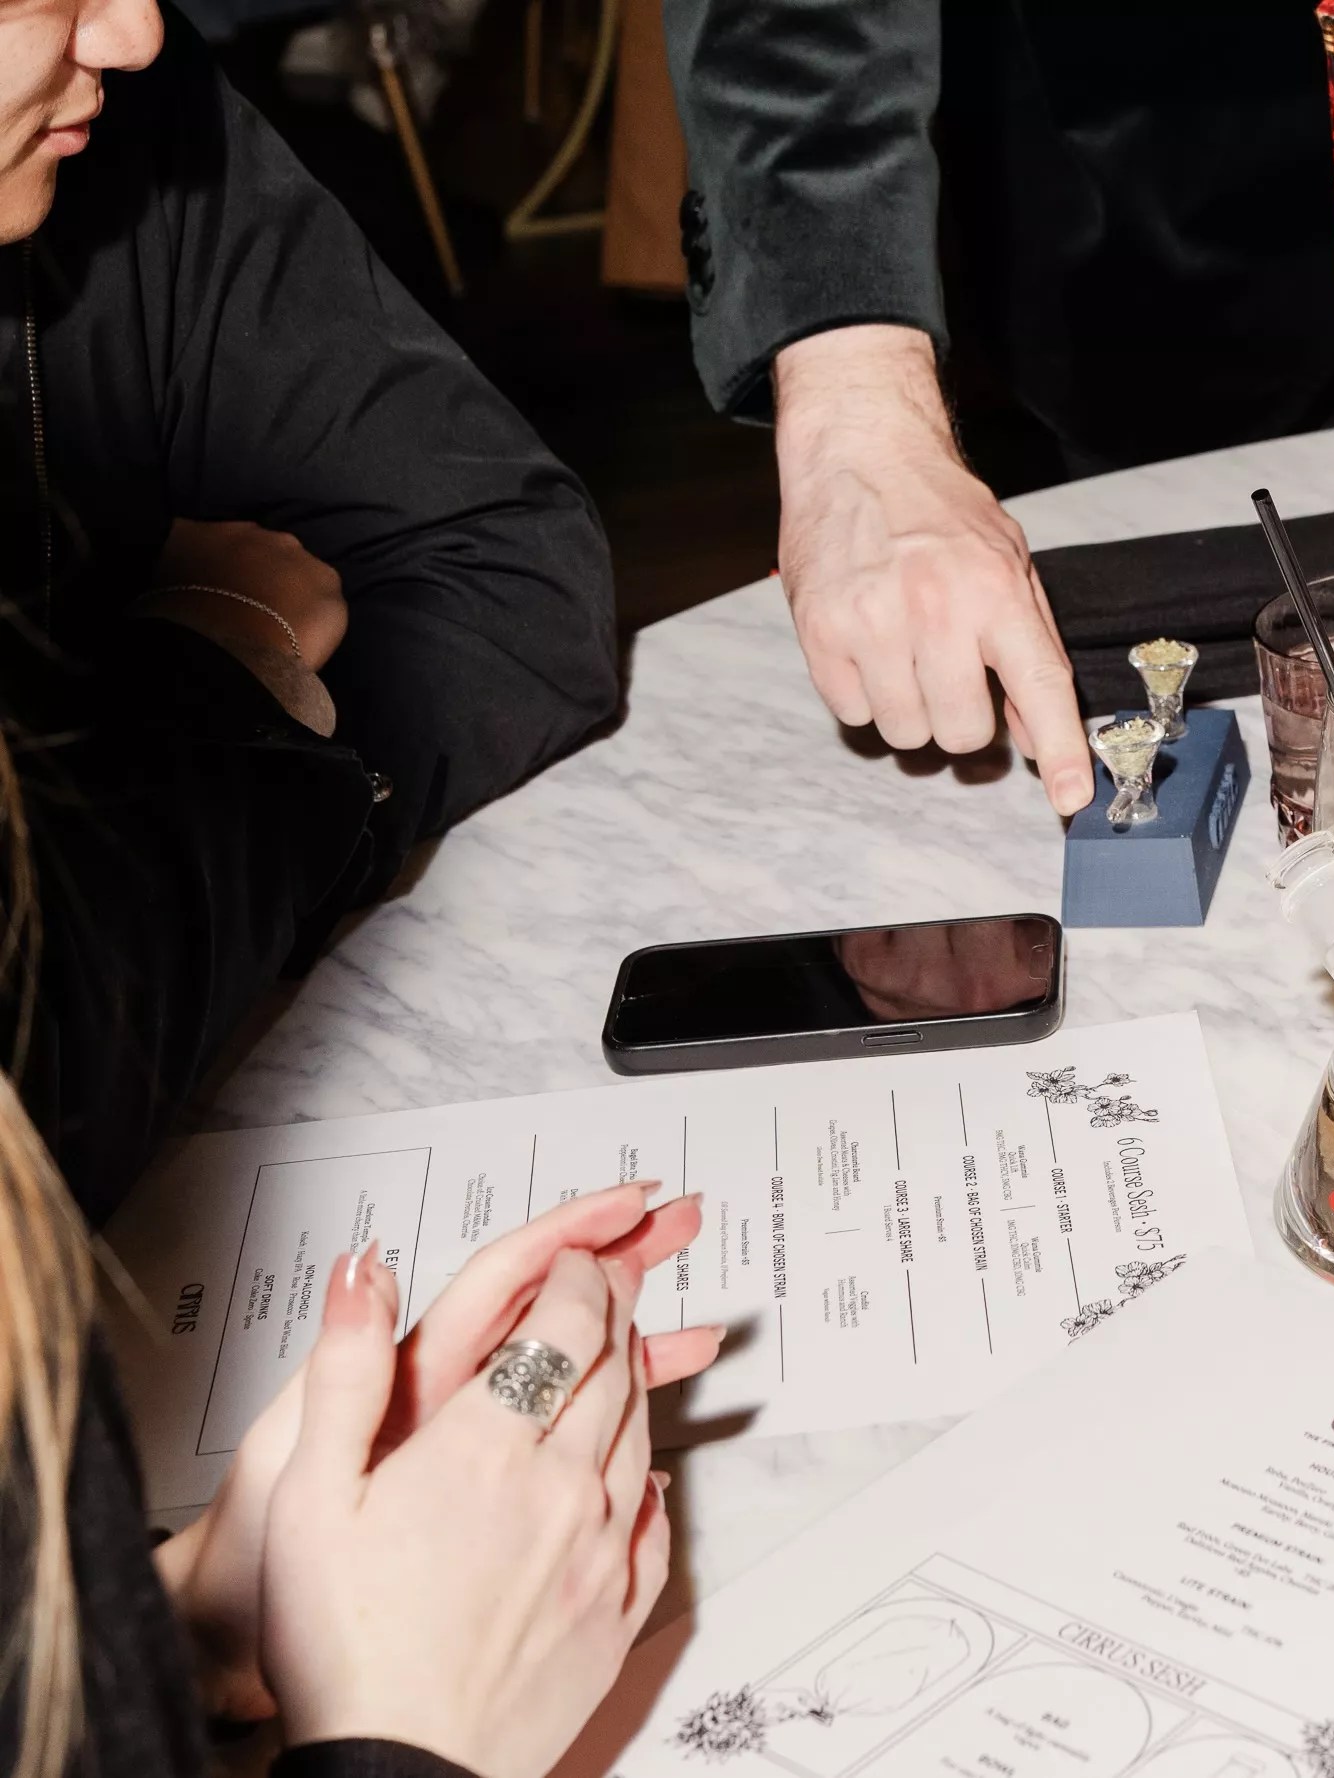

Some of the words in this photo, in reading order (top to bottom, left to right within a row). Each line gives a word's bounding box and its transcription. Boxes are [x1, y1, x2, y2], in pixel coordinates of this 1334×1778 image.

[1116, 1137, 1143, 1145] 6
[852, 1168, 861, 1182] Board
[962, 1155, 976, 1181] COURSE
[1119, 1147, 1145, 1188] Course
[771, 1176, 783, 1202] COURSE
[894, 1180, 908, 1206] COURSE
[1051, 1168, 1066, 1194] COURSE
[966, 1192, 979, 1205] BAG
[968, 1207, 981, 1215] OF
[1127, 1189, 1157, 1219] Sesh
[772, 1213, 784, 1232] BOWL
[897, 1217, 911, 1239] LARGE
[969, 1217, 984, 1245] CHOSEN
[1056, 1204, 1072, 1233] STARTER
[772, 1233, 784, 1242] OF
[1134, 1227, 1164, 1250] $75
[677, 1249, 689, 1262] ALL
[773, 1244, 785, 1271] CHOSEN
[899, 1240, 913, 1263] SHARE
[973, 1246, 987, 1270] STRAIN
[253, 1268, 263, 1281] Coke
[263, 1274, 275, 1291] SOFT
[676, 1263, 688, 1291] SHARES
[773, 1273, 786, 1298] STRAIN
[249, 1283, 260, 1299] Coke
[297, 1264, 315, 1320] NON-ALCOHOLIC
[172, 1283, 204, 1335] CIRRUS
[257, 1293, 271, 1320] DRINKS
[1058, 1621, 1145, 1670] CIRRUS
[1140, 1658, 1207, 1697] SESH
